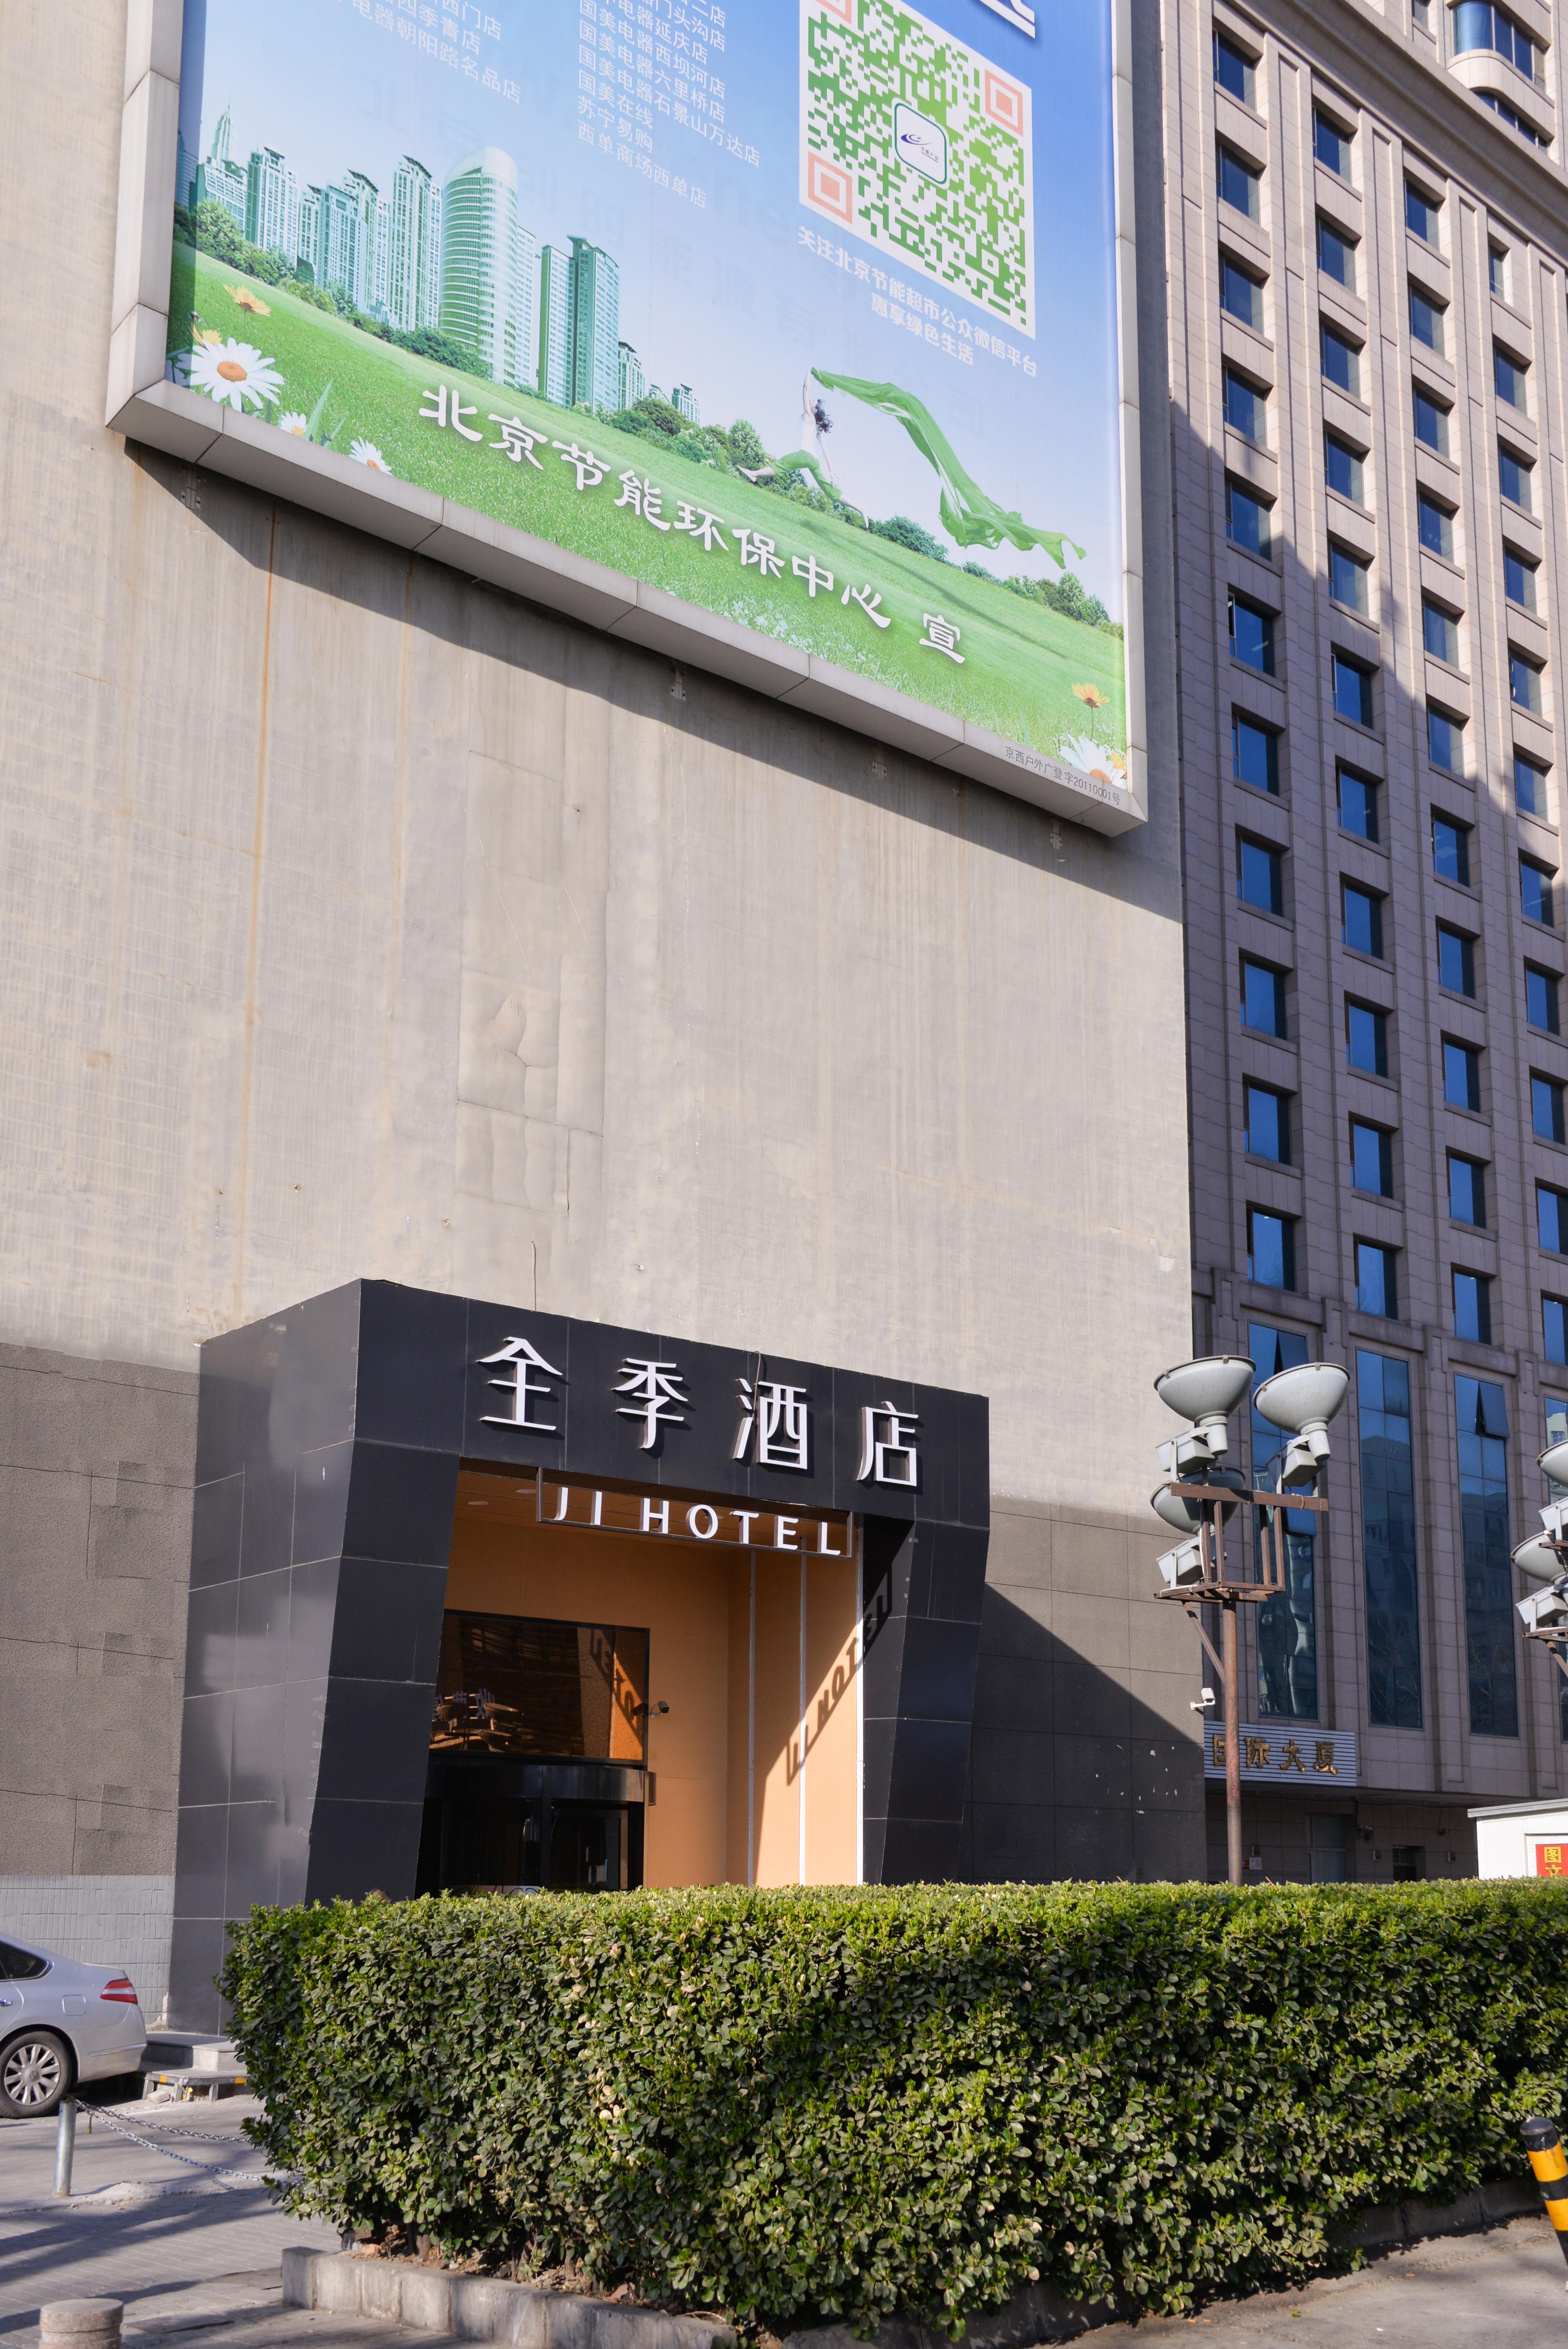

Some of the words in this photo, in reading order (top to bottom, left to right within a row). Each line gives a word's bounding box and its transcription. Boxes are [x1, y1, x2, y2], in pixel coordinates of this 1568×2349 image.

[338, 0, 521, 104] 电器朝阳路名品店
[386, 0, 480, 55] 四季青店
[434, 0, 501, 41] 西门店
[579, 0, 725, 100] 国美电器西坝河店
[606, 0, 707, 65] 电器延庆店
[642, 0, 725, 52] 门头沟店
[578, 69, 653, 129] 国美在线
[579, 19, 725, 123] 国美电器六里桥店
[579, 44, 760, 168] 国美电器石景山万达店
[577, 94, 653, 153] 苏宁易购
[577, 119, 706, 209] 西单商场西单店
[798, 225, 1037, 378] 关注北京节能超市公众微信平台
[871, 292, 974, 366] 惠享绿色生活
[419, 385, 892, 629] 北京节能环保中心
[919, 612, 966, 664] 宣
[1005, 746, 1121, 805] 京西户外广登字20110001号
[476, 1336, 919, 1486] 全季酒店
[553, 1486, 603, 1526] JI
[639, 1497, 841, 1556] HOTEL
[1213, 1734, 1338, 1777] 国际大厦
